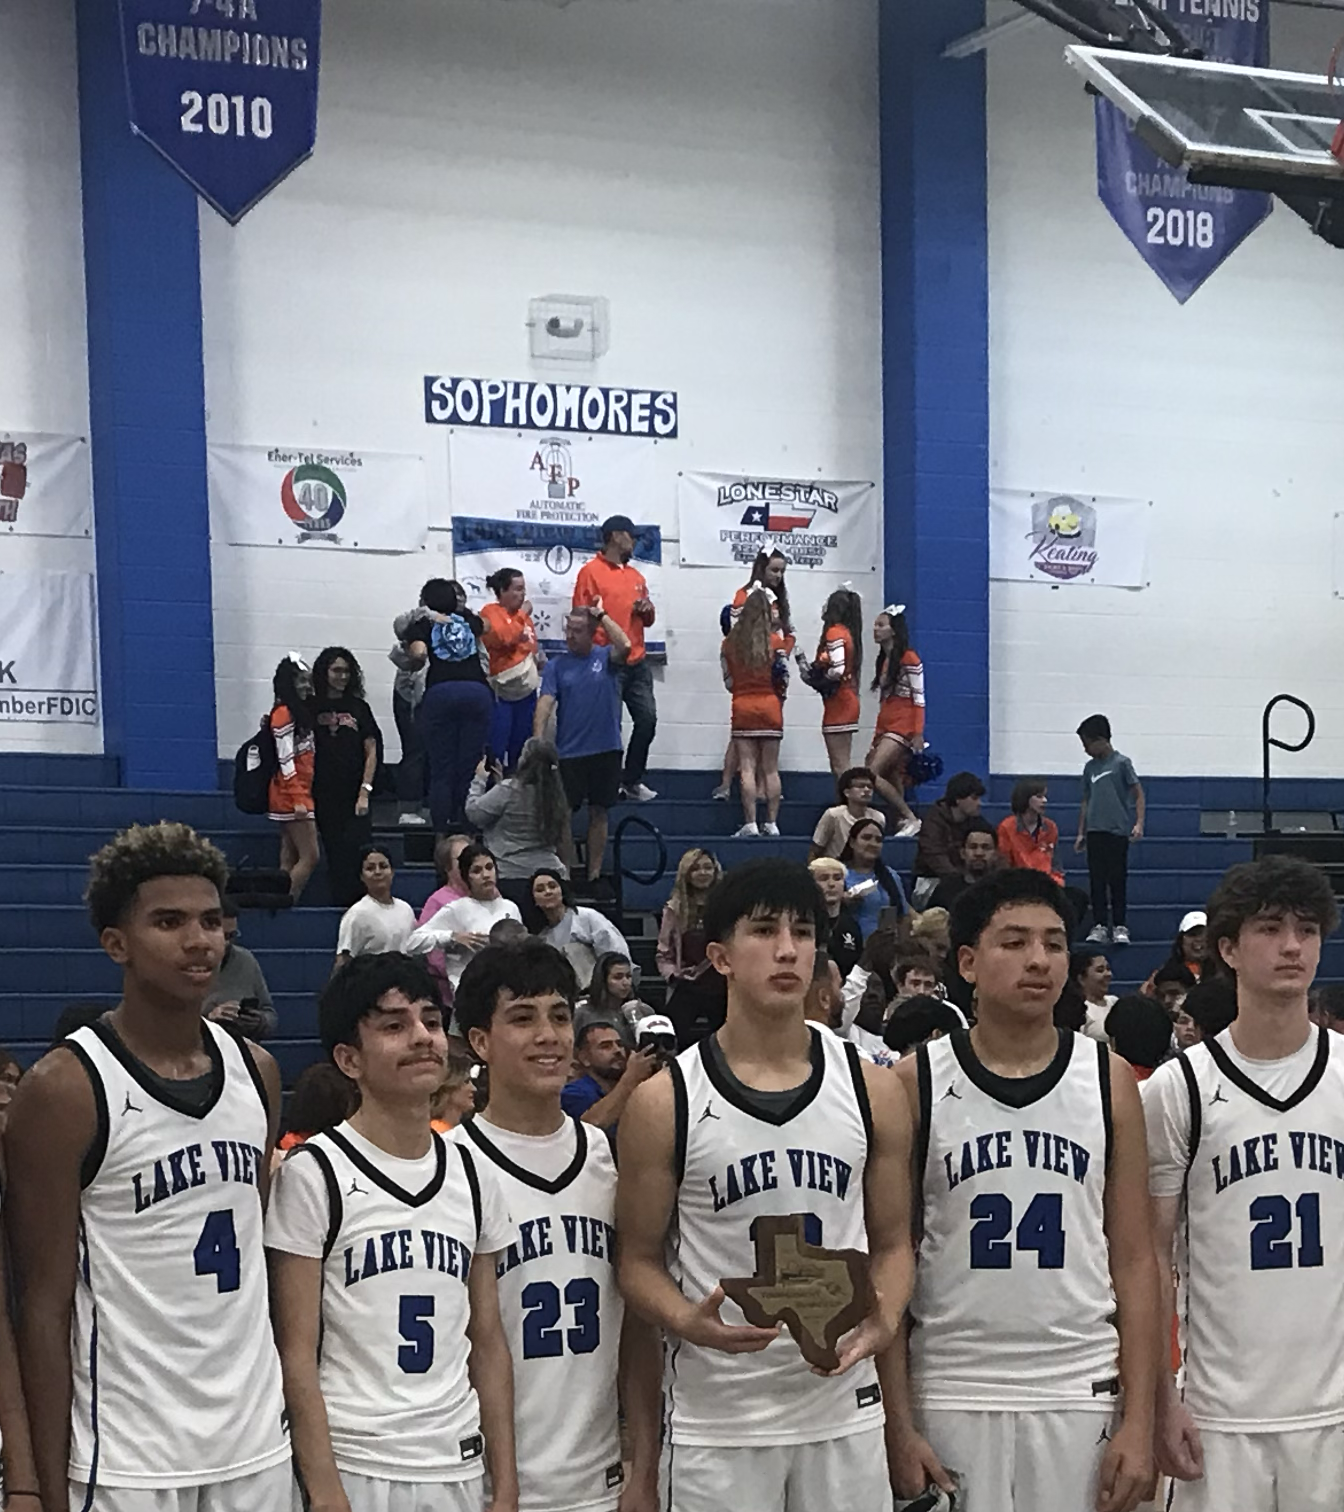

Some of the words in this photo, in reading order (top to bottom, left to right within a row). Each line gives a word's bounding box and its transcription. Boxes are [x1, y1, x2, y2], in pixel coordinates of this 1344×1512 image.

[137, 22, 308, 71] CHAMPIONS
[180, 90, 273, 139] 2010
[1146, 206, 1214, 249] 2018
[431, 376, 677, 435] SOPHOMORES
[298, 483, 329, 512] 40
[529, 500, 586, 510] AUTOMATIC
[540, 510, 599, 522] PROTECTION
[717, 482, 839, 513] LONESTAR
[719, 529, 838, 548] PERFORMANCE
[1024, 531, 1099, 573] Keating
[131, 1143, 206, 1214] LAKE
[708, 1149, 778, 1213] LAKE
[786, 1148, 853, 1202] VIEW
[944, 1129, 1012, 1193] LAKE
[1022, 1129, 1091, 1186] VIEW
[1211, 1132, 1279, 1195] LAKE
[192, 1208, 241, 1294] 4
[343, 1229, 414, 1289] LAKE
[969, 1192, 1066, 1269] 24
[1249, 1192, 1324, 1271] 21
[397, 1294, 435, 1374] 5
[521, 1276, 601, 1361] 23
